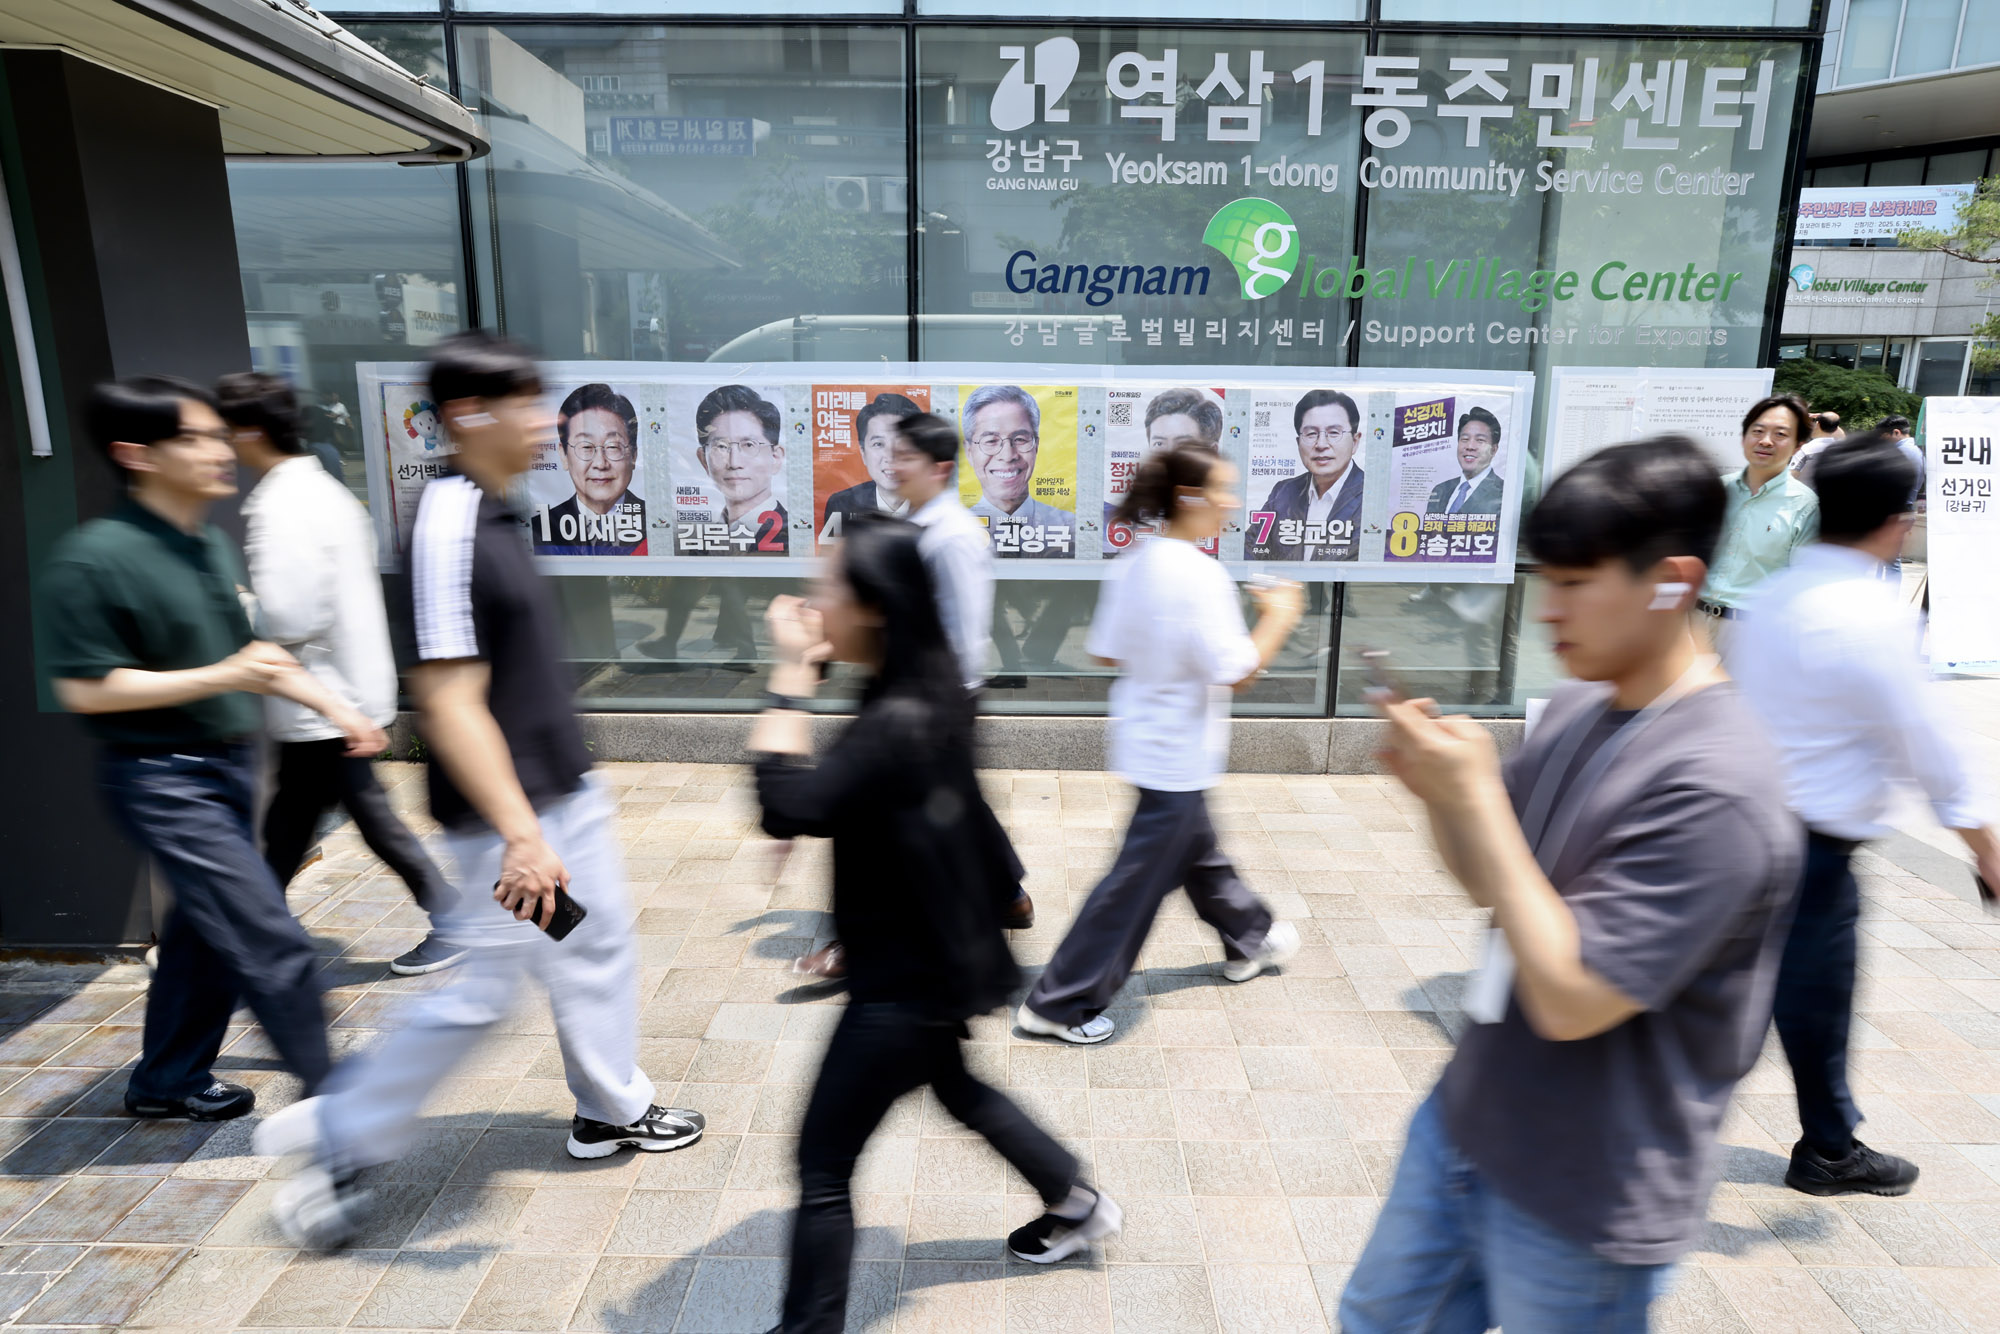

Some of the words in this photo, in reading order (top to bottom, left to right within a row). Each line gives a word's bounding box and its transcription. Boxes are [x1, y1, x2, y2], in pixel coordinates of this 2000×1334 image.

[1106, 49, 1774, 150] 역삼1동주민센터
[985, 139, 1083, 173] 강남구
[986, 178, 1026, 191] GANG
[1027, 178, 1058, 191] NAM
[1059, 178, 1079, 191] GU
[1106, 152, 1227, 185] Yeoksam
[1240, 155, 1339, 192] 1-dong
[1360, 155, 1525, 197] Community
[1535, 160, 1643, 195] Service
[1654, 163, 1755, 196] Center
[1797, 202, 1867, 218] 주민센터로
[1869, 200, 1937, 217] 신청하세요
[1005, 250, 1210, 306] Gangnam
[1425, 256, 1579, 313] Village
[1590, 261, 1742, 302] Center
[1844, 279, 1885, 295] Village
[1887, 281, 1928, 293] Center
[1365, 320, 1475, 347] Support
[1486, 321, 1578, 346] Center
[1588, 322, 1624, 346] for
[1634, 324, 1728, 348] Expats
[817, 391, 867, 410] 미래를
[817, 410, 850, 429] 여는
[1404, 402, 1446, 424] 선경제,
[817, 429, 851, 448] 선택
[1941, 436, 1992, 465] 관내
[531, 463, 558, 471] 대한민국
[1251, 468, 1276, 476] 청년에게
[1277, 468, 1295, 476] 미래를
[676, 486, 700, 495] 새롭게
[1035, 487, 1056, 496] 불평등
[1056, 487, 1070, 496] 세상
[1941, 478, 1992, 497] 선거인
[614, 503, 641, 513] 지금은
[676, 496, 708, 505] 대한민국
[535, 504, 552, 541] 1
[559, 513, 643, 542] 이재명
[677, 523, 756, 551] 김문수
[757, 510, 784, 551] 2
[1107, 517, 1134, 548] 6
[1250, 511, 1276, 544] 7
[1278, 519, 1354, 545] 황교안
[1467, 521, 1496, 533] 해결사
[994, 525, 1072, 553] 권영국
[1390, 511, 1420, 557] 8
[1427, 534, 1494, 556] 송진호
